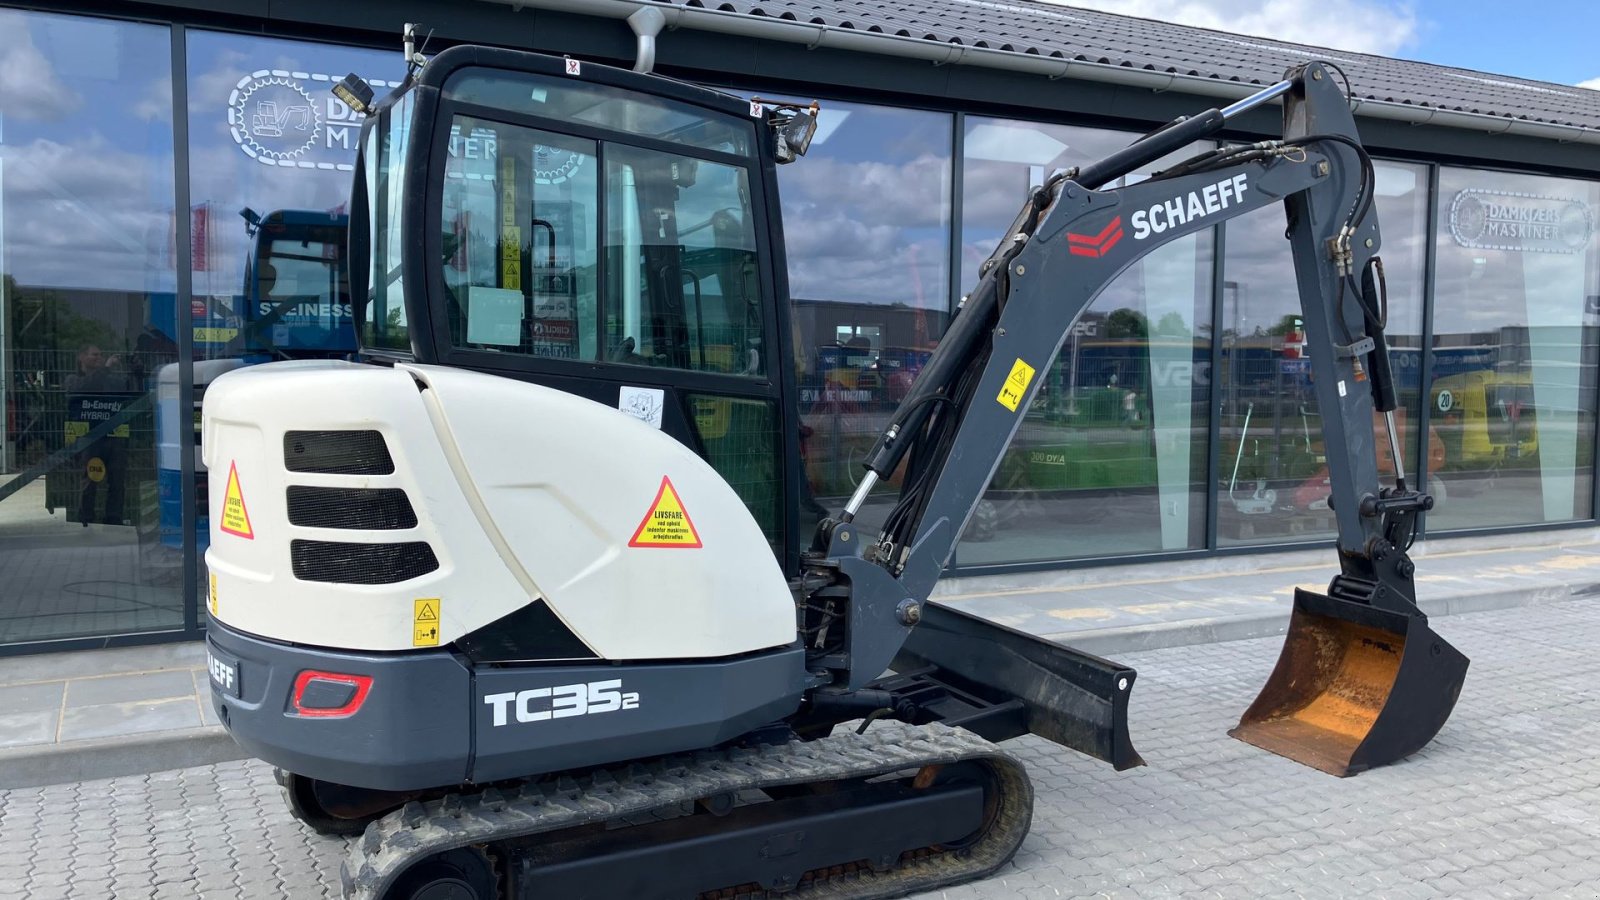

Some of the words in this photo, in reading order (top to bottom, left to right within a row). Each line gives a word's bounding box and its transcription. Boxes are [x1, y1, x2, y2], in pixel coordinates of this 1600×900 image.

[1131, 173, 1248, 240] SCHAEFF
[1487, 223, 1560, 240] MASKINER
[1440, 392, 1450, 408] 20
[80, 411, 110, 420] HYBRID
[654, 510, 683, 520] LIVSFARE
